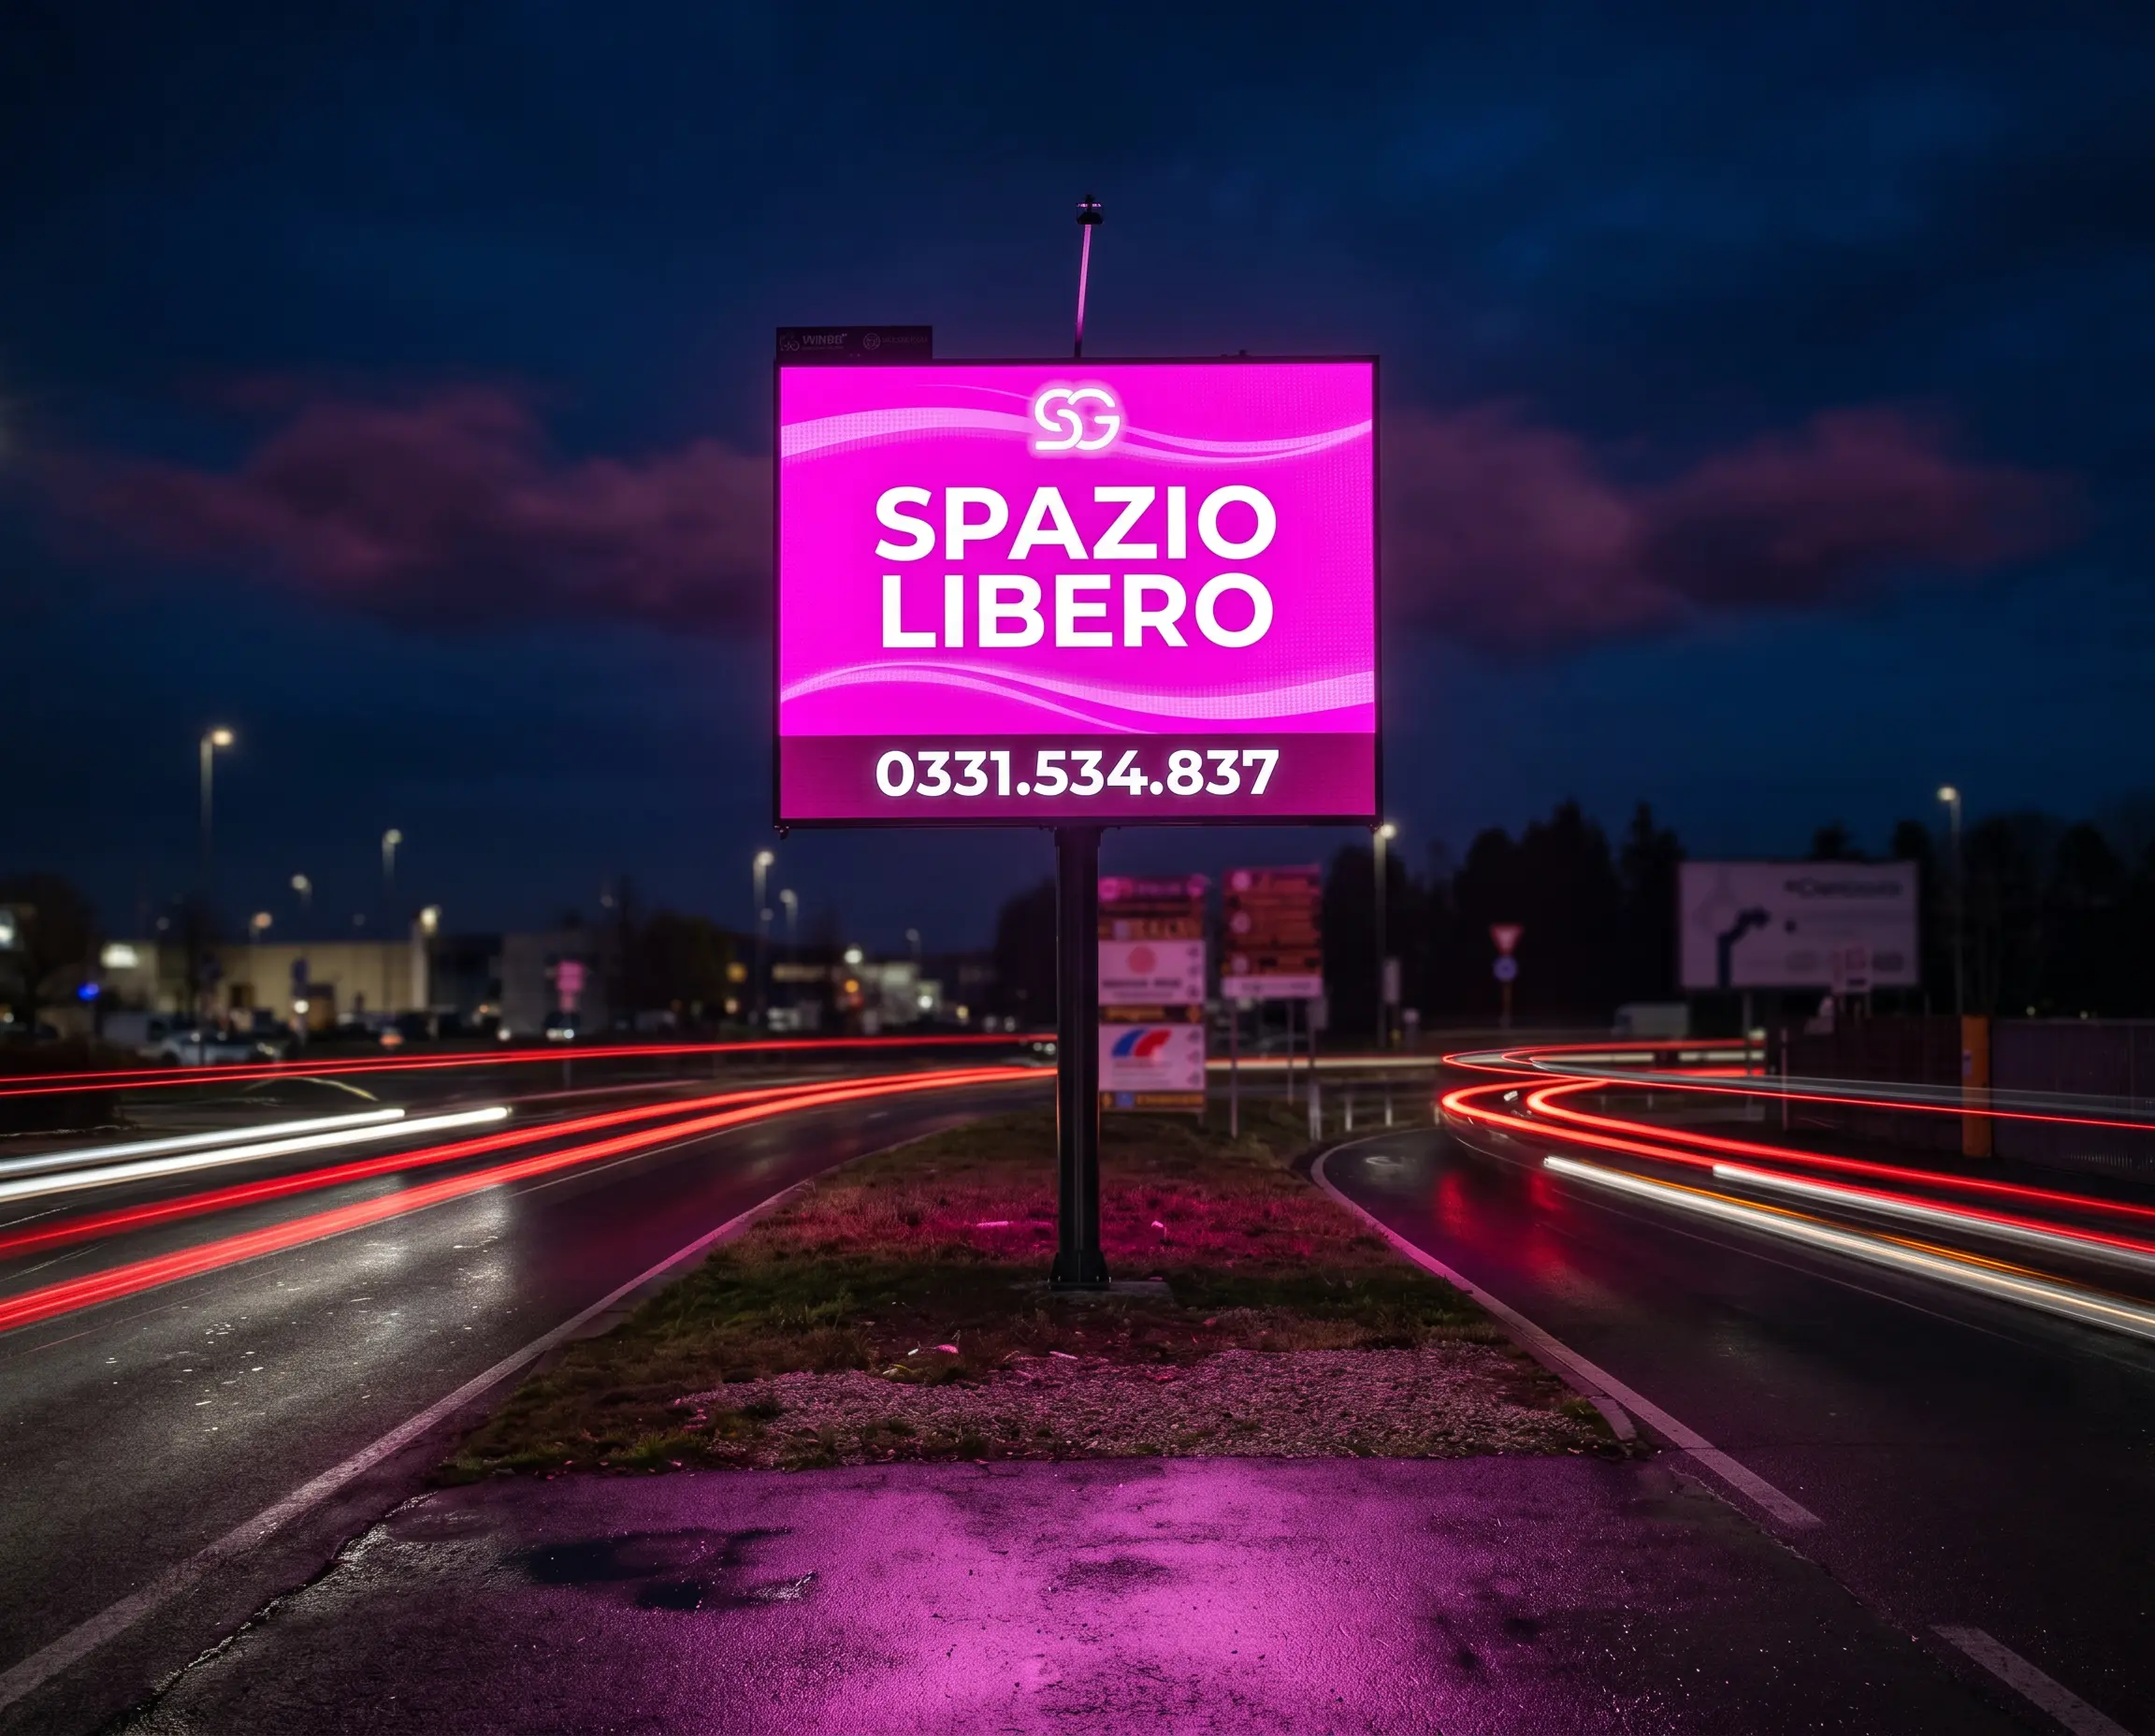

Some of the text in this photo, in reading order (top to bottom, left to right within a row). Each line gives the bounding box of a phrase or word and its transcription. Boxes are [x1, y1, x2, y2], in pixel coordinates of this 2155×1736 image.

[1034, 388, 1121, 450] SG
[875, 485, 1277, 561] SPAZIO
[882, 572, 1273, 648] LIBERO
[875, 749, 1280, 797] 0331.534.837
